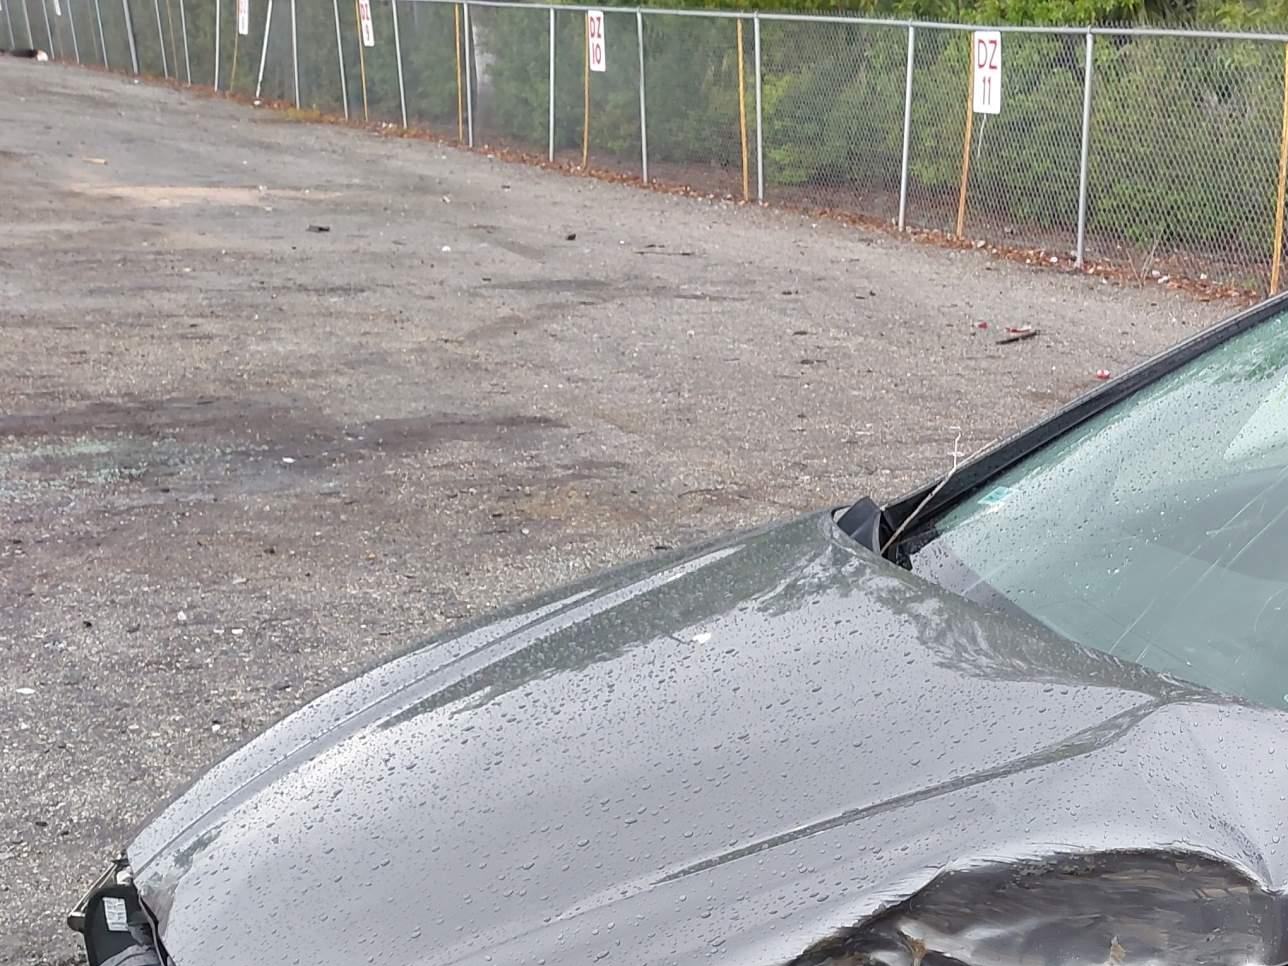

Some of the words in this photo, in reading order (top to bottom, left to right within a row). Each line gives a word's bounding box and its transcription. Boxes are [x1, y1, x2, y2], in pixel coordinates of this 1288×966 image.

[590, 16, 602, 38] DZ
[592, 43, 602, 65] 10
[977, 39, 998, 70] DZ
[982, 76, 992, 105] 11
